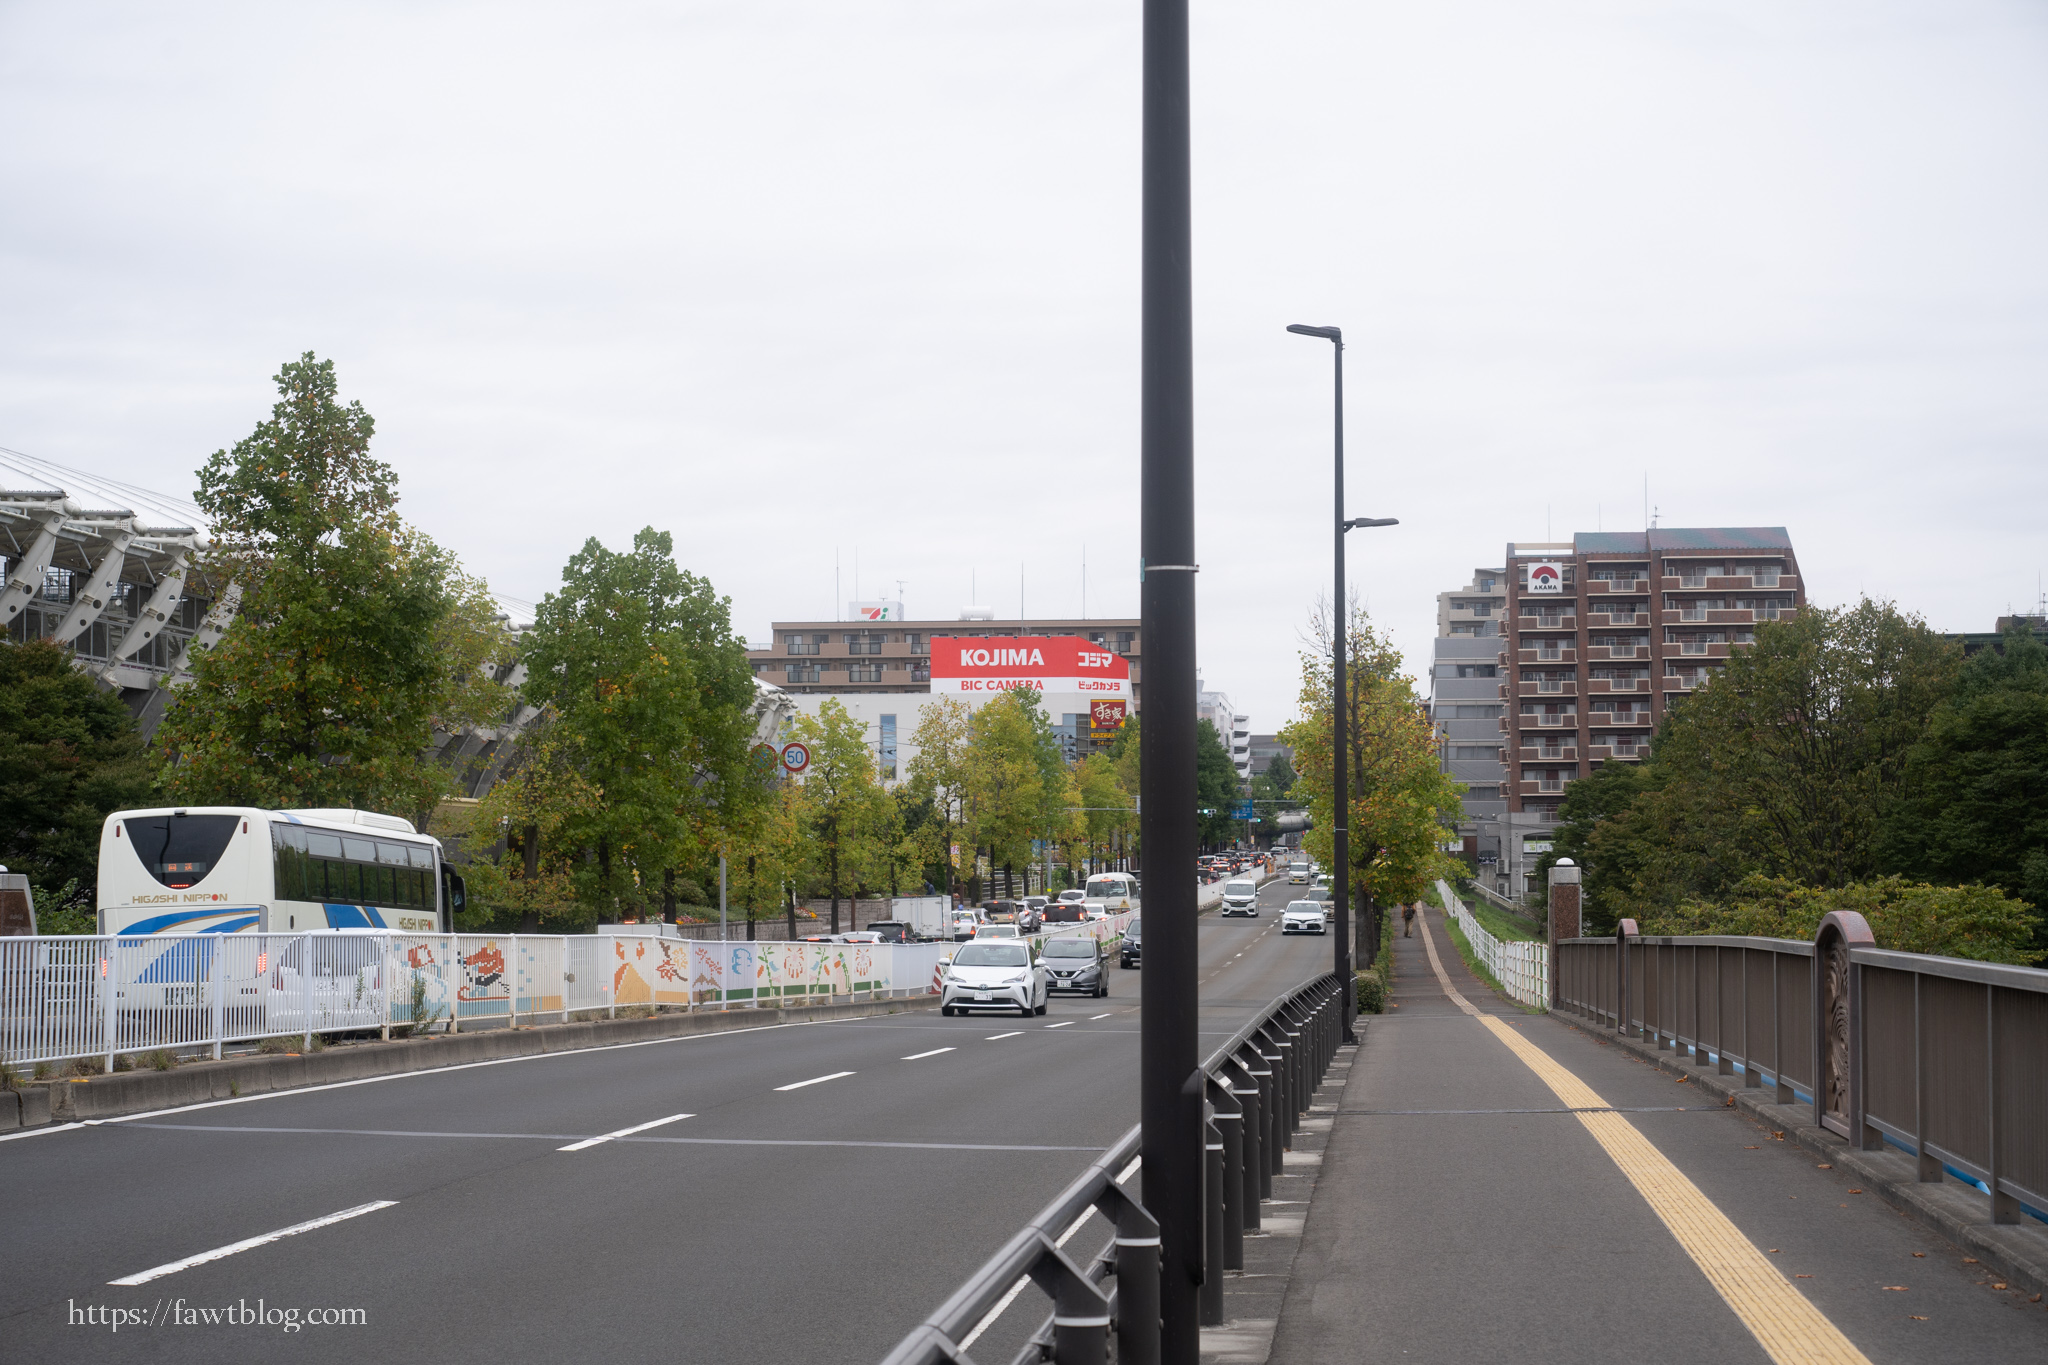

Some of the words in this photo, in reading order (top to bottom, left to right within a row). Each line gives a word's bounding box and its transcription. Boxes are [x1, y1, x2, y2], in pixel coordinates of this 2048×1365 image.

[961, 649, 1044, 666] KOJIMA
[1078, 652, 1113, 667] コジマ
[961, 680, 983, 691] BIC
[986, 680, 1044, 691] CAMERA
[1078, 681, 1120, 690] ビックカメラ
[1094, 702, 1122, 721] すき家
[787, 750, 804, 764] 50
[168, 862, 192, 872] 回送
[132, 894, 178, 904] HIGASHI
[183, 894, 228, 902] NIPPON
[398, 917, 416, 930] HIGASHI
[418, 918, 434, 930] NIPPON
